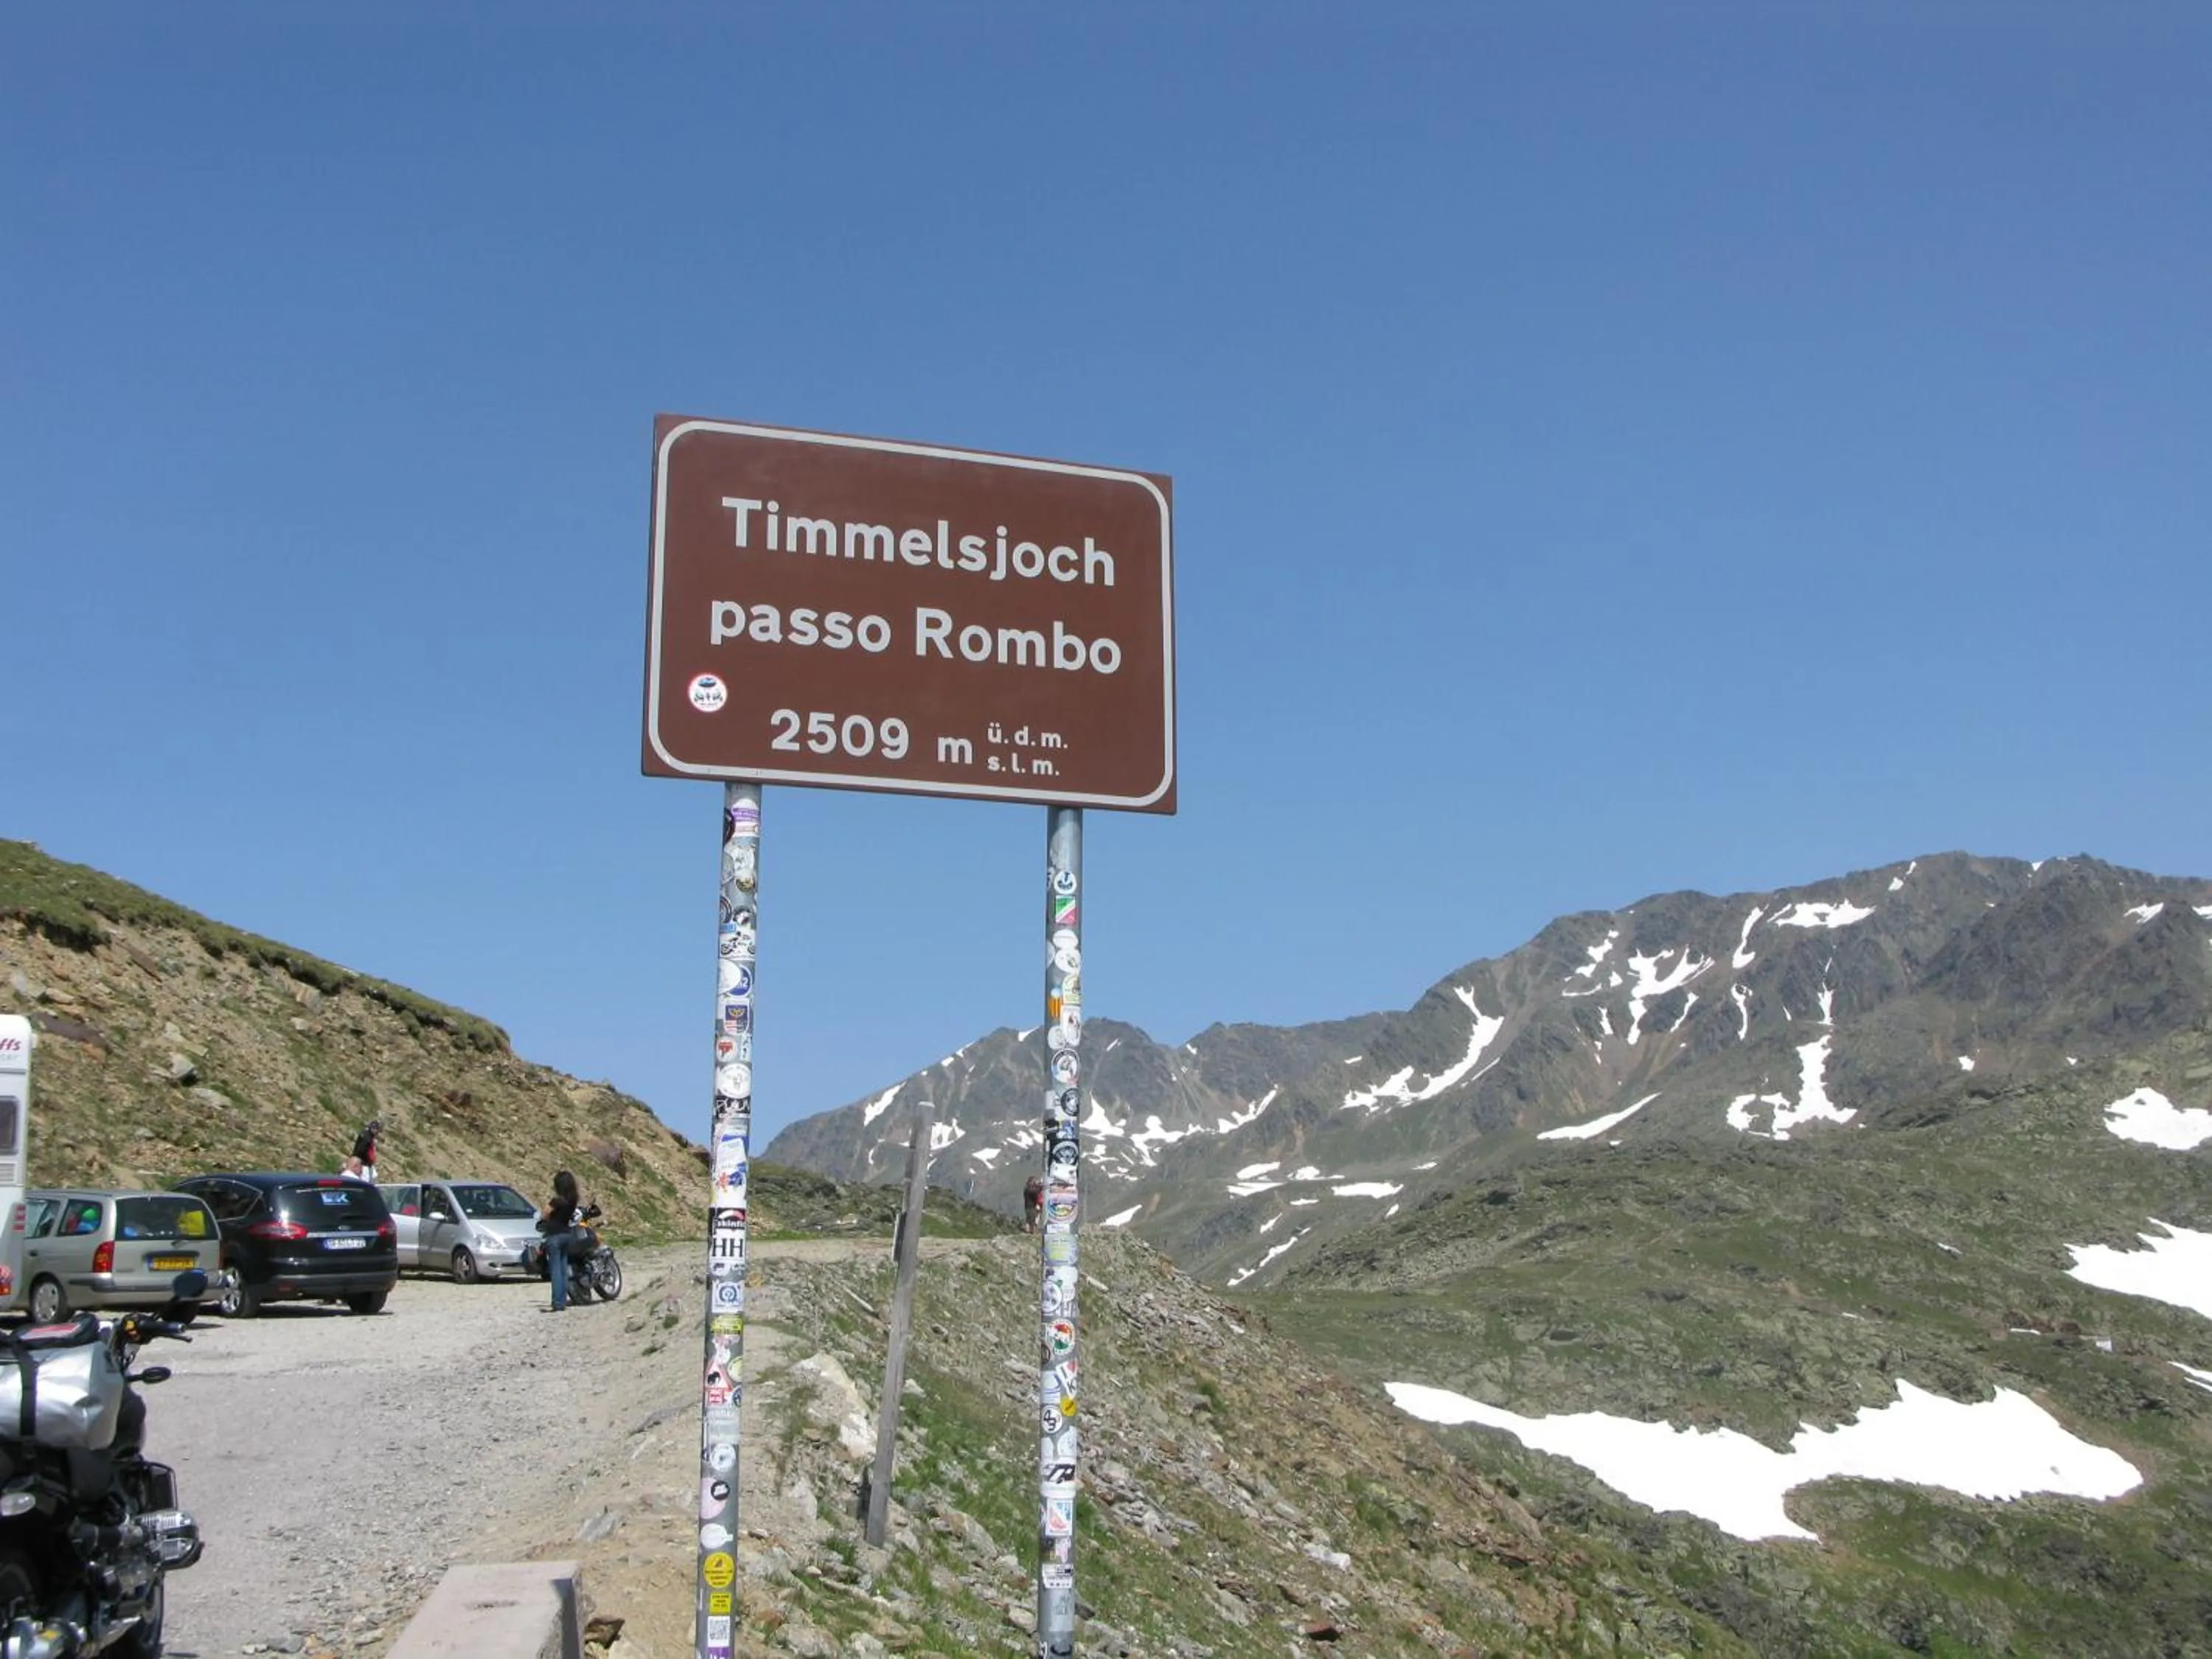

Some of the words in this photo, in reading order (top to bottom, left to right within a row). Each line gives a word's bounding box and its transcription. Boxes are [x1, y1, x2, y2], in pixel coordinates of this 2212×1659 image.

[721, 496, 1115, 586] Timmelsjoch
[710, 600, 891, 653] passo
[916, 607, 1121, 674] Rombo
[771, 709, 909, 759] 2509
[937, 737, 973, 765] m
